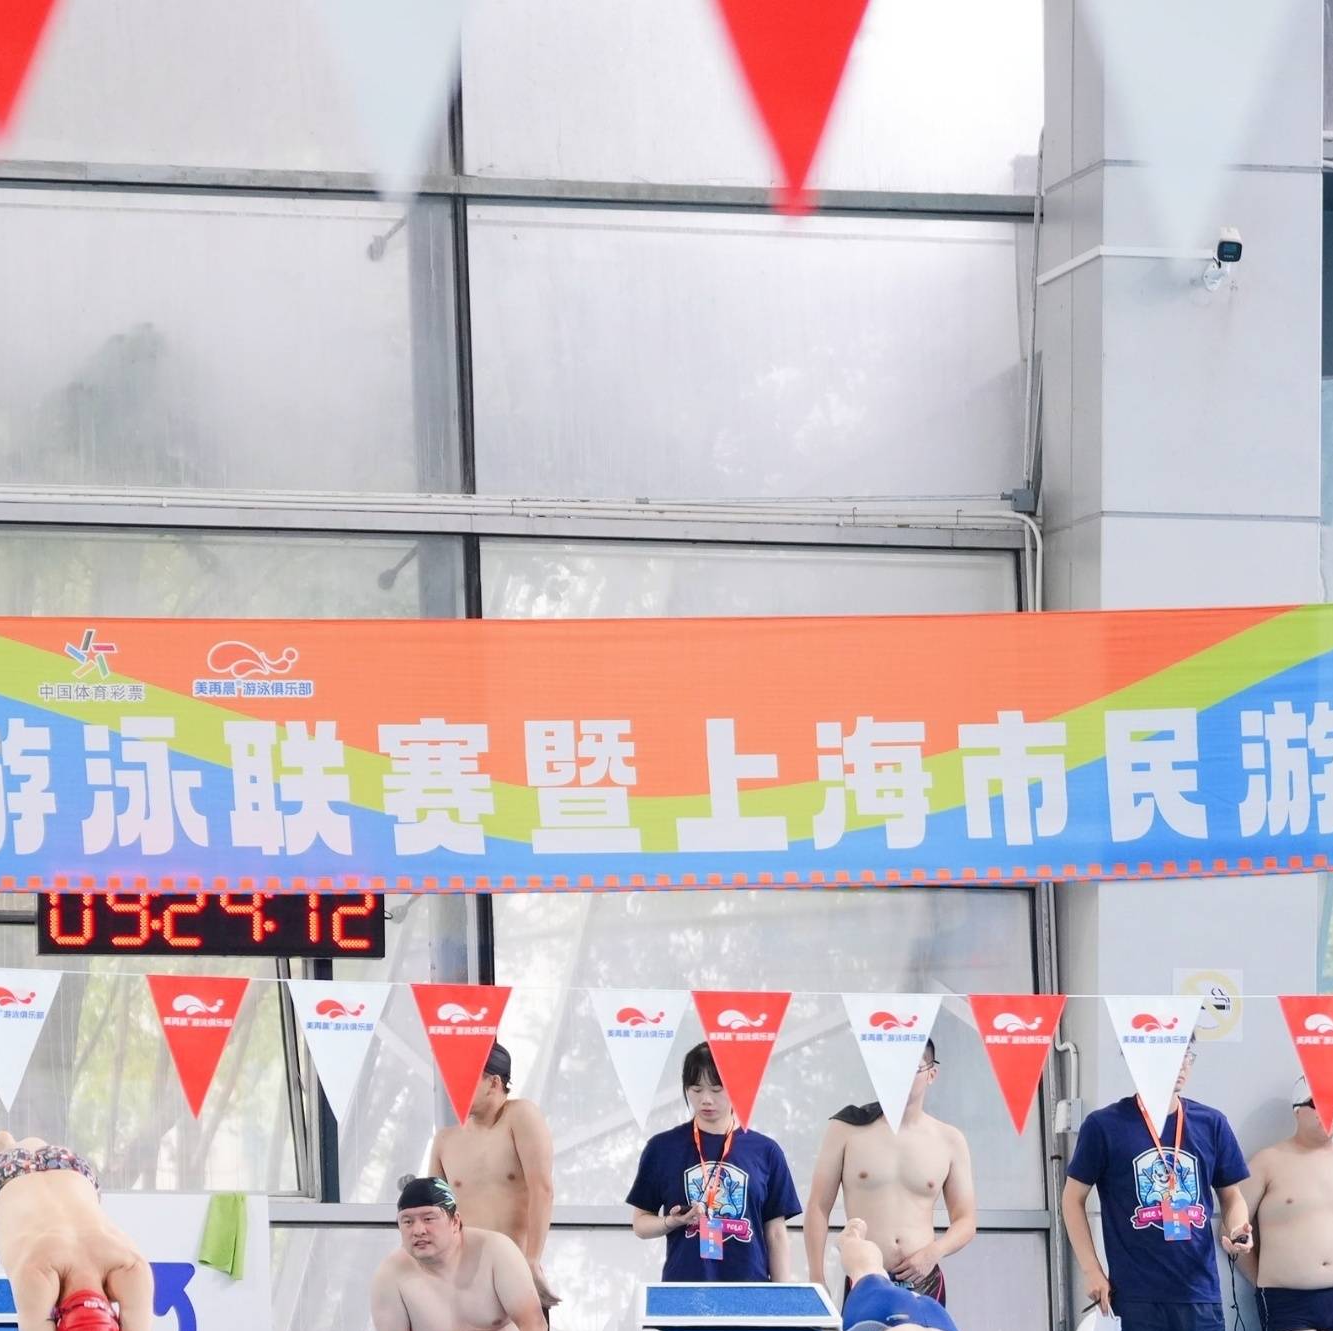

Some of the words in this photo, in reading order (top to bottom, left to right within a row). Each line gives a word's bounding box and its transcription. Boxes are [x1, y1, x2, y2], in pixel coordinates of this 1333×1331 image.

[39, 684, 145, 701] 中国体育彩票
